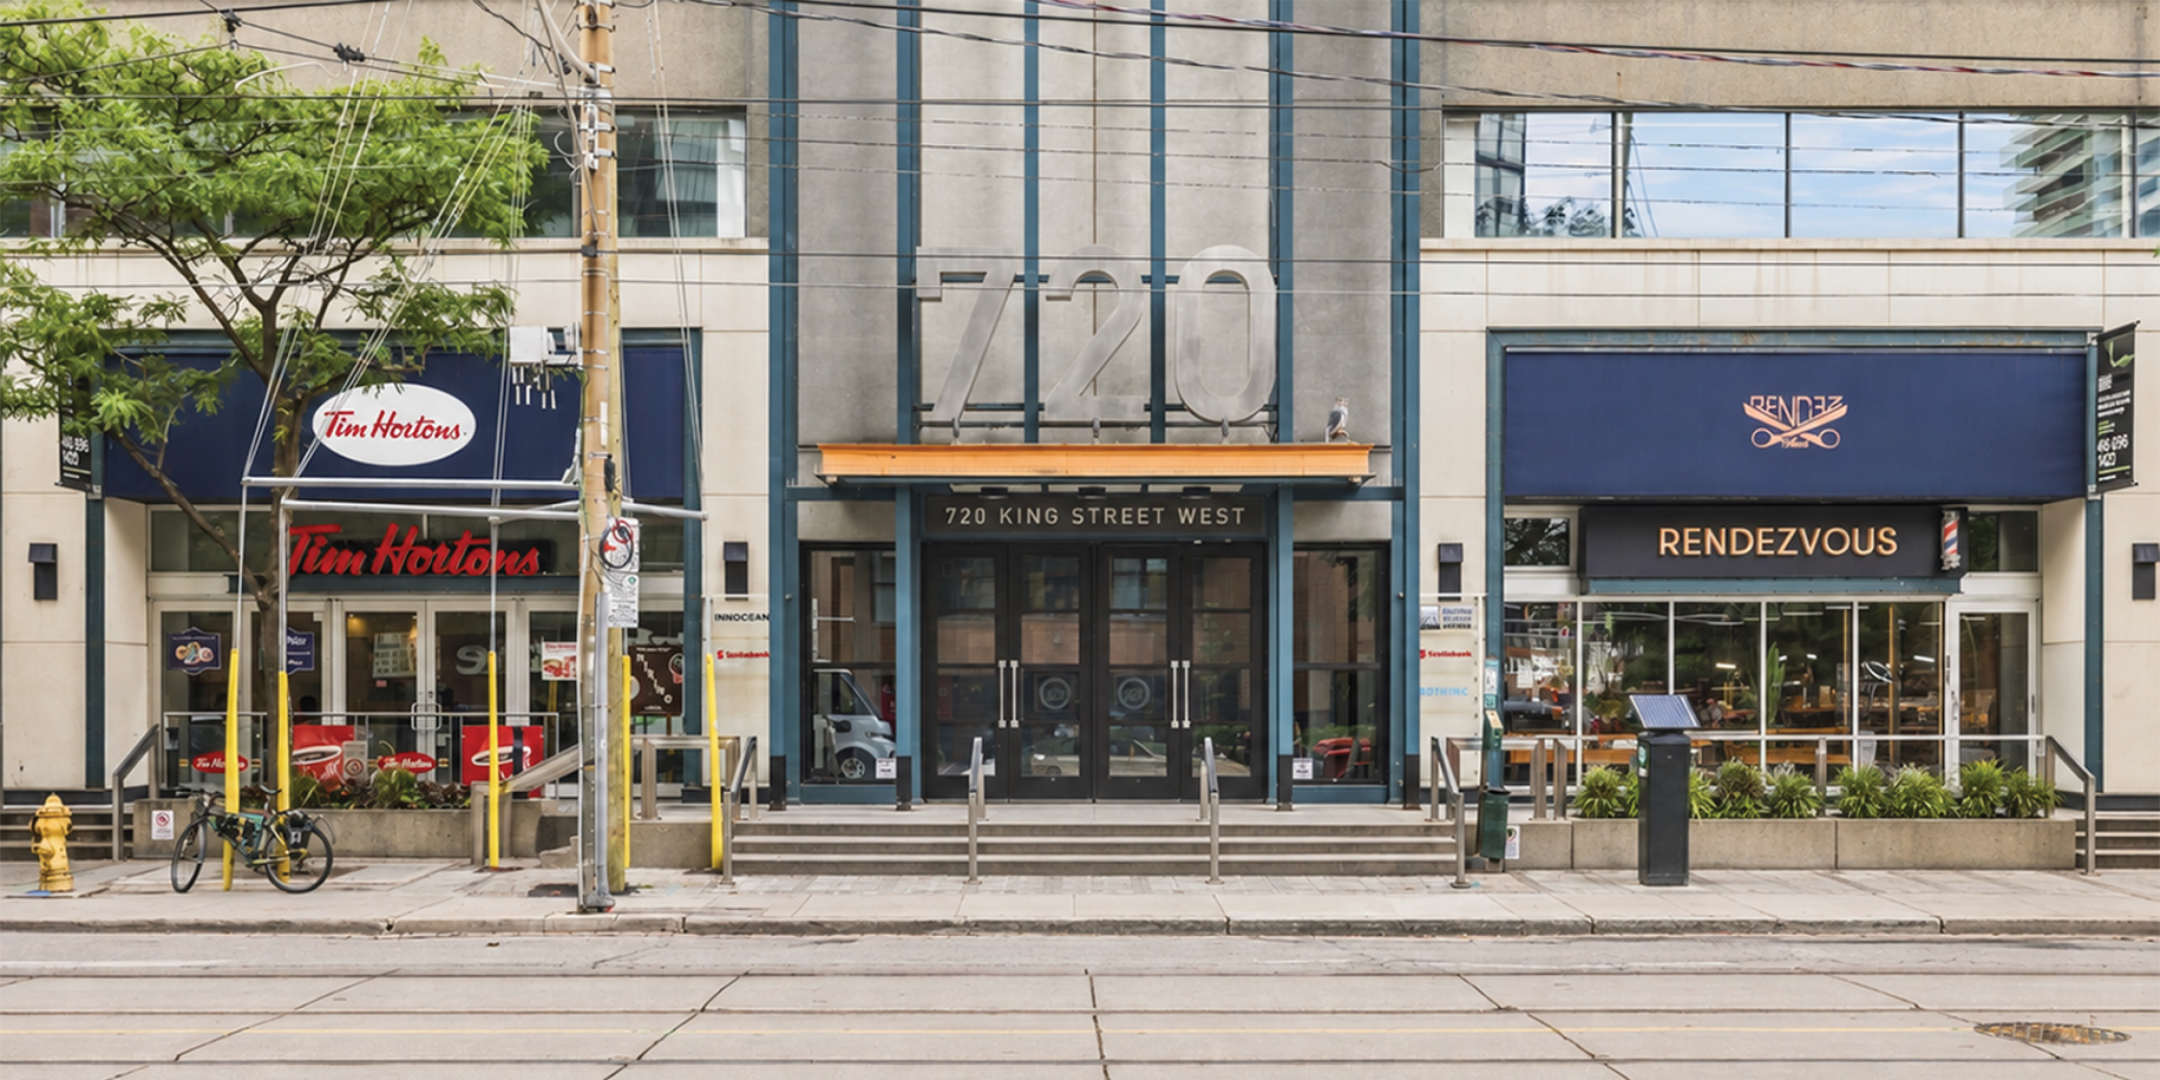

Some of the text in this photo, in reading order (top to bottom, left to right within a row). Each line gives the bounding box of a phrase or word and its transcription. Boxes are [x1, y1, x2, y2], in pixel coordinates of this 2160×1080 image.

[916, 244, 1277, 424] 720
[324, 410, 461, 440] Tim Hortons
[945, 507, 1246, 525] 720 KING STREET WEST
[288, 522, 540, 576] Tim Hortons
[1658, 527, 1898, 556] RENDEZVOUS
[714, 613, 770, 622] INNOCEAN
[1428, 650, 1472, 658] Scotiabank
